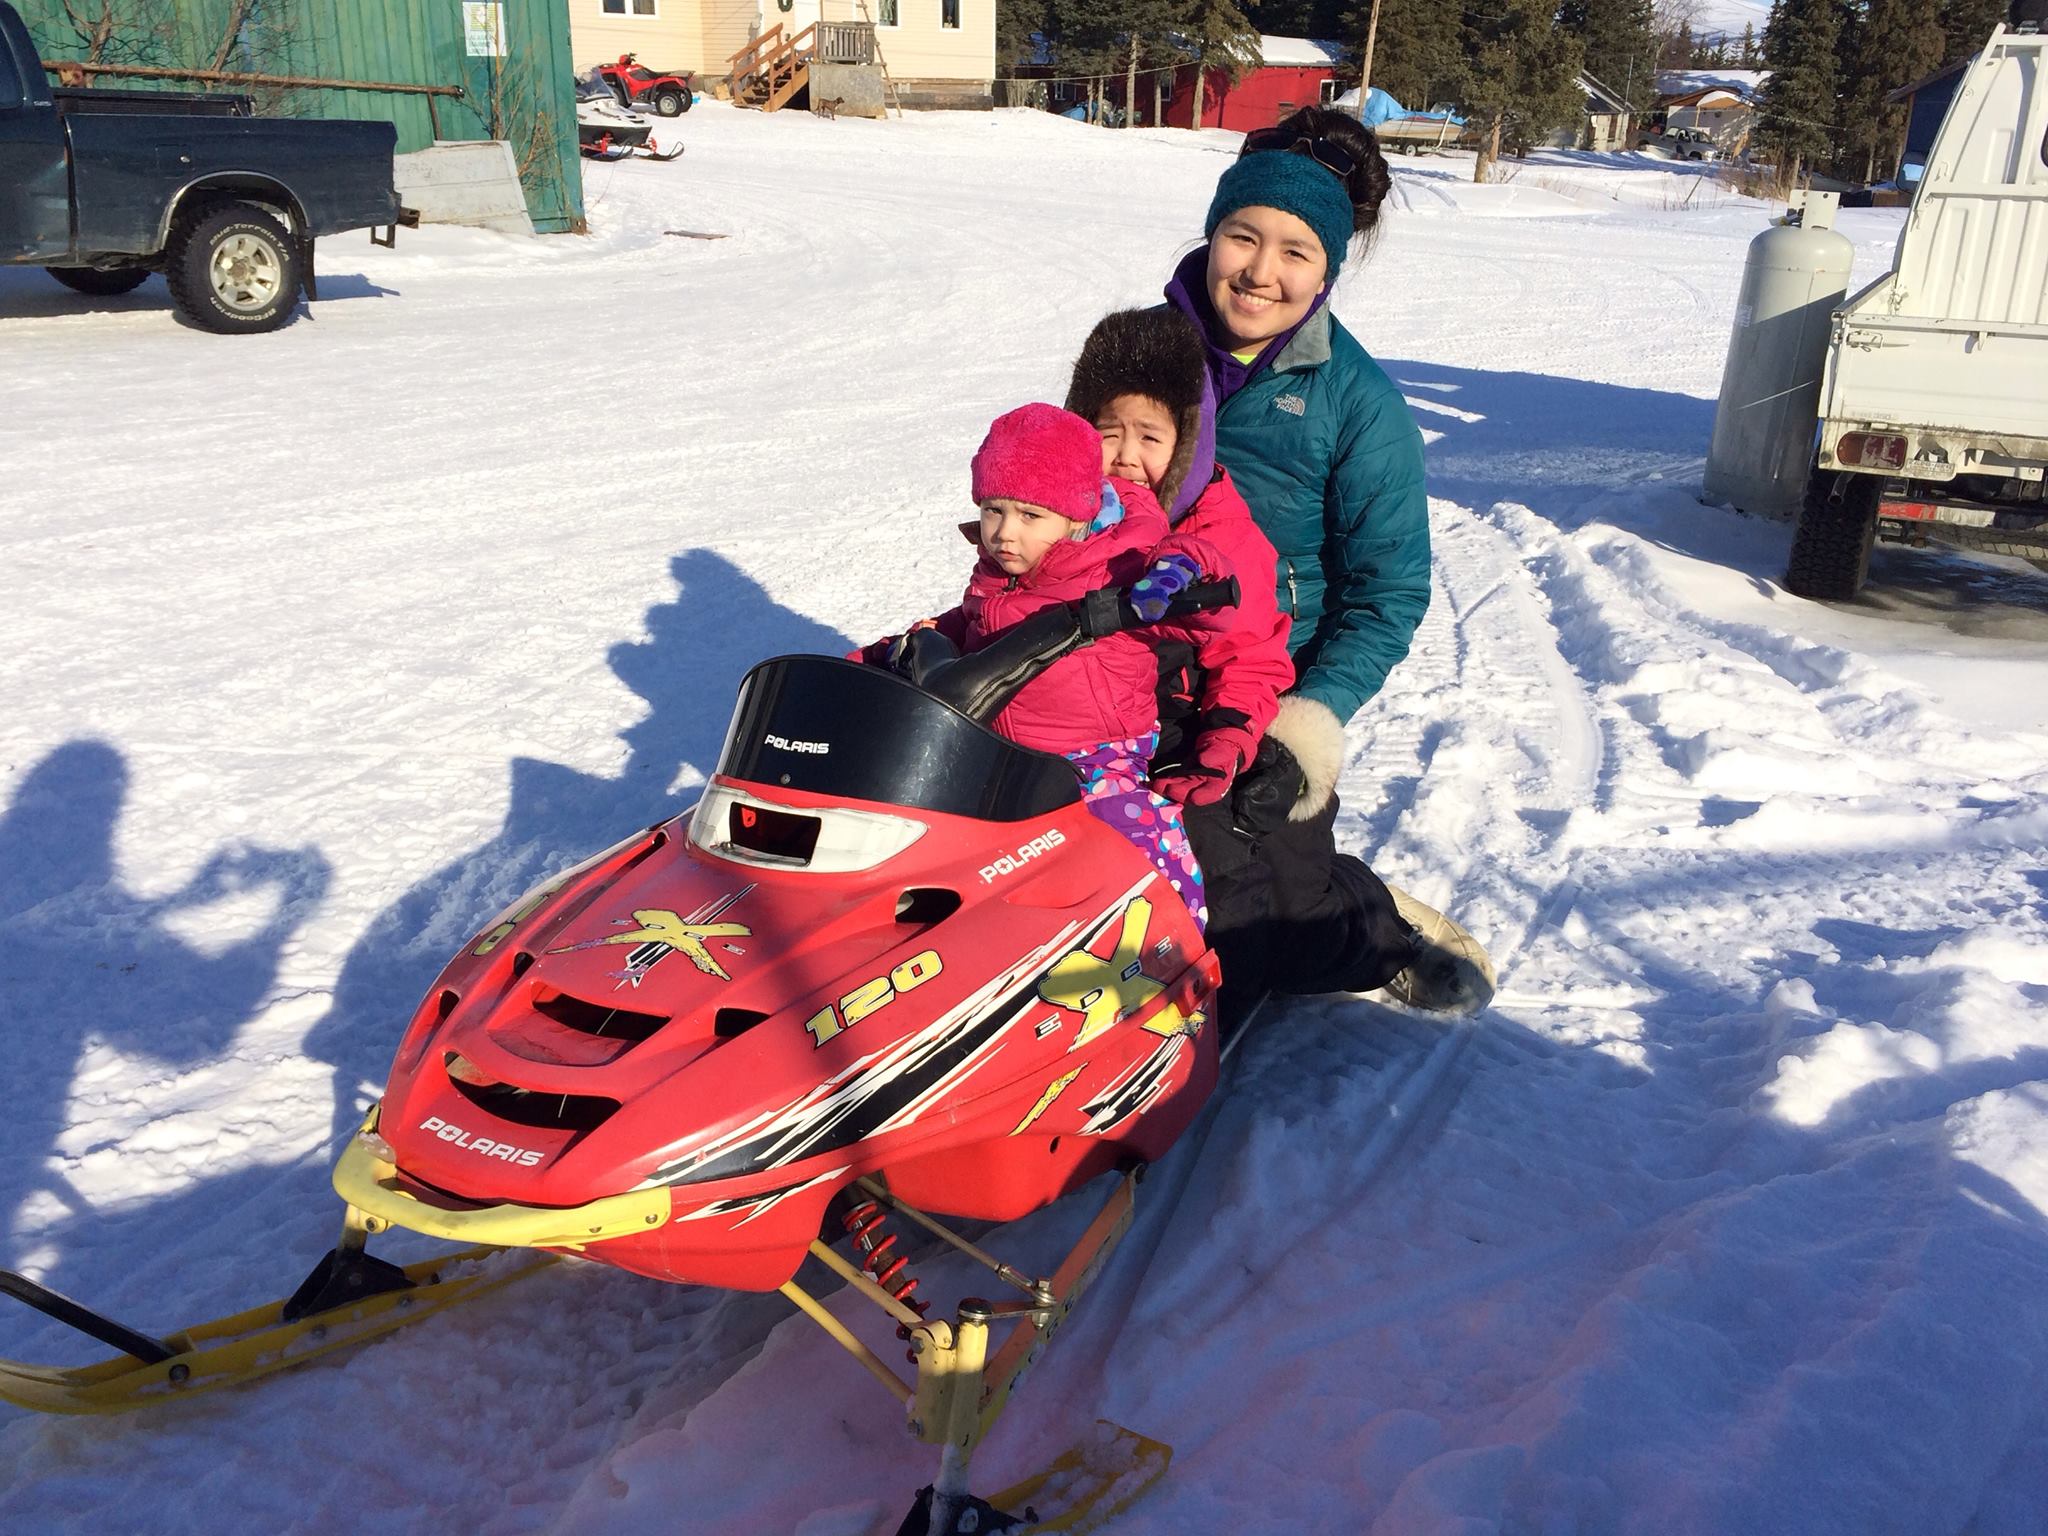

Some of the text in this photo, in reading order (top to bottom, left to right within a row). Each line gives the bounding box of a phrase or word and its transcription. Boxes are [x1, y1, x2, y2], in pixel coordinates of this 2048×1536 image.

[1273, 397, 1296, 409] NORTH
[1285, 393, 1298, 403] THE
[1276, 404, 1294, 414] FACE
[764, 734, 830, 754] POLARIS
[978, 828, 1066, 884] POLARIS
[804, 949, 944, 1051] 120
[419, 1116, 545, 1167] POLARIS
